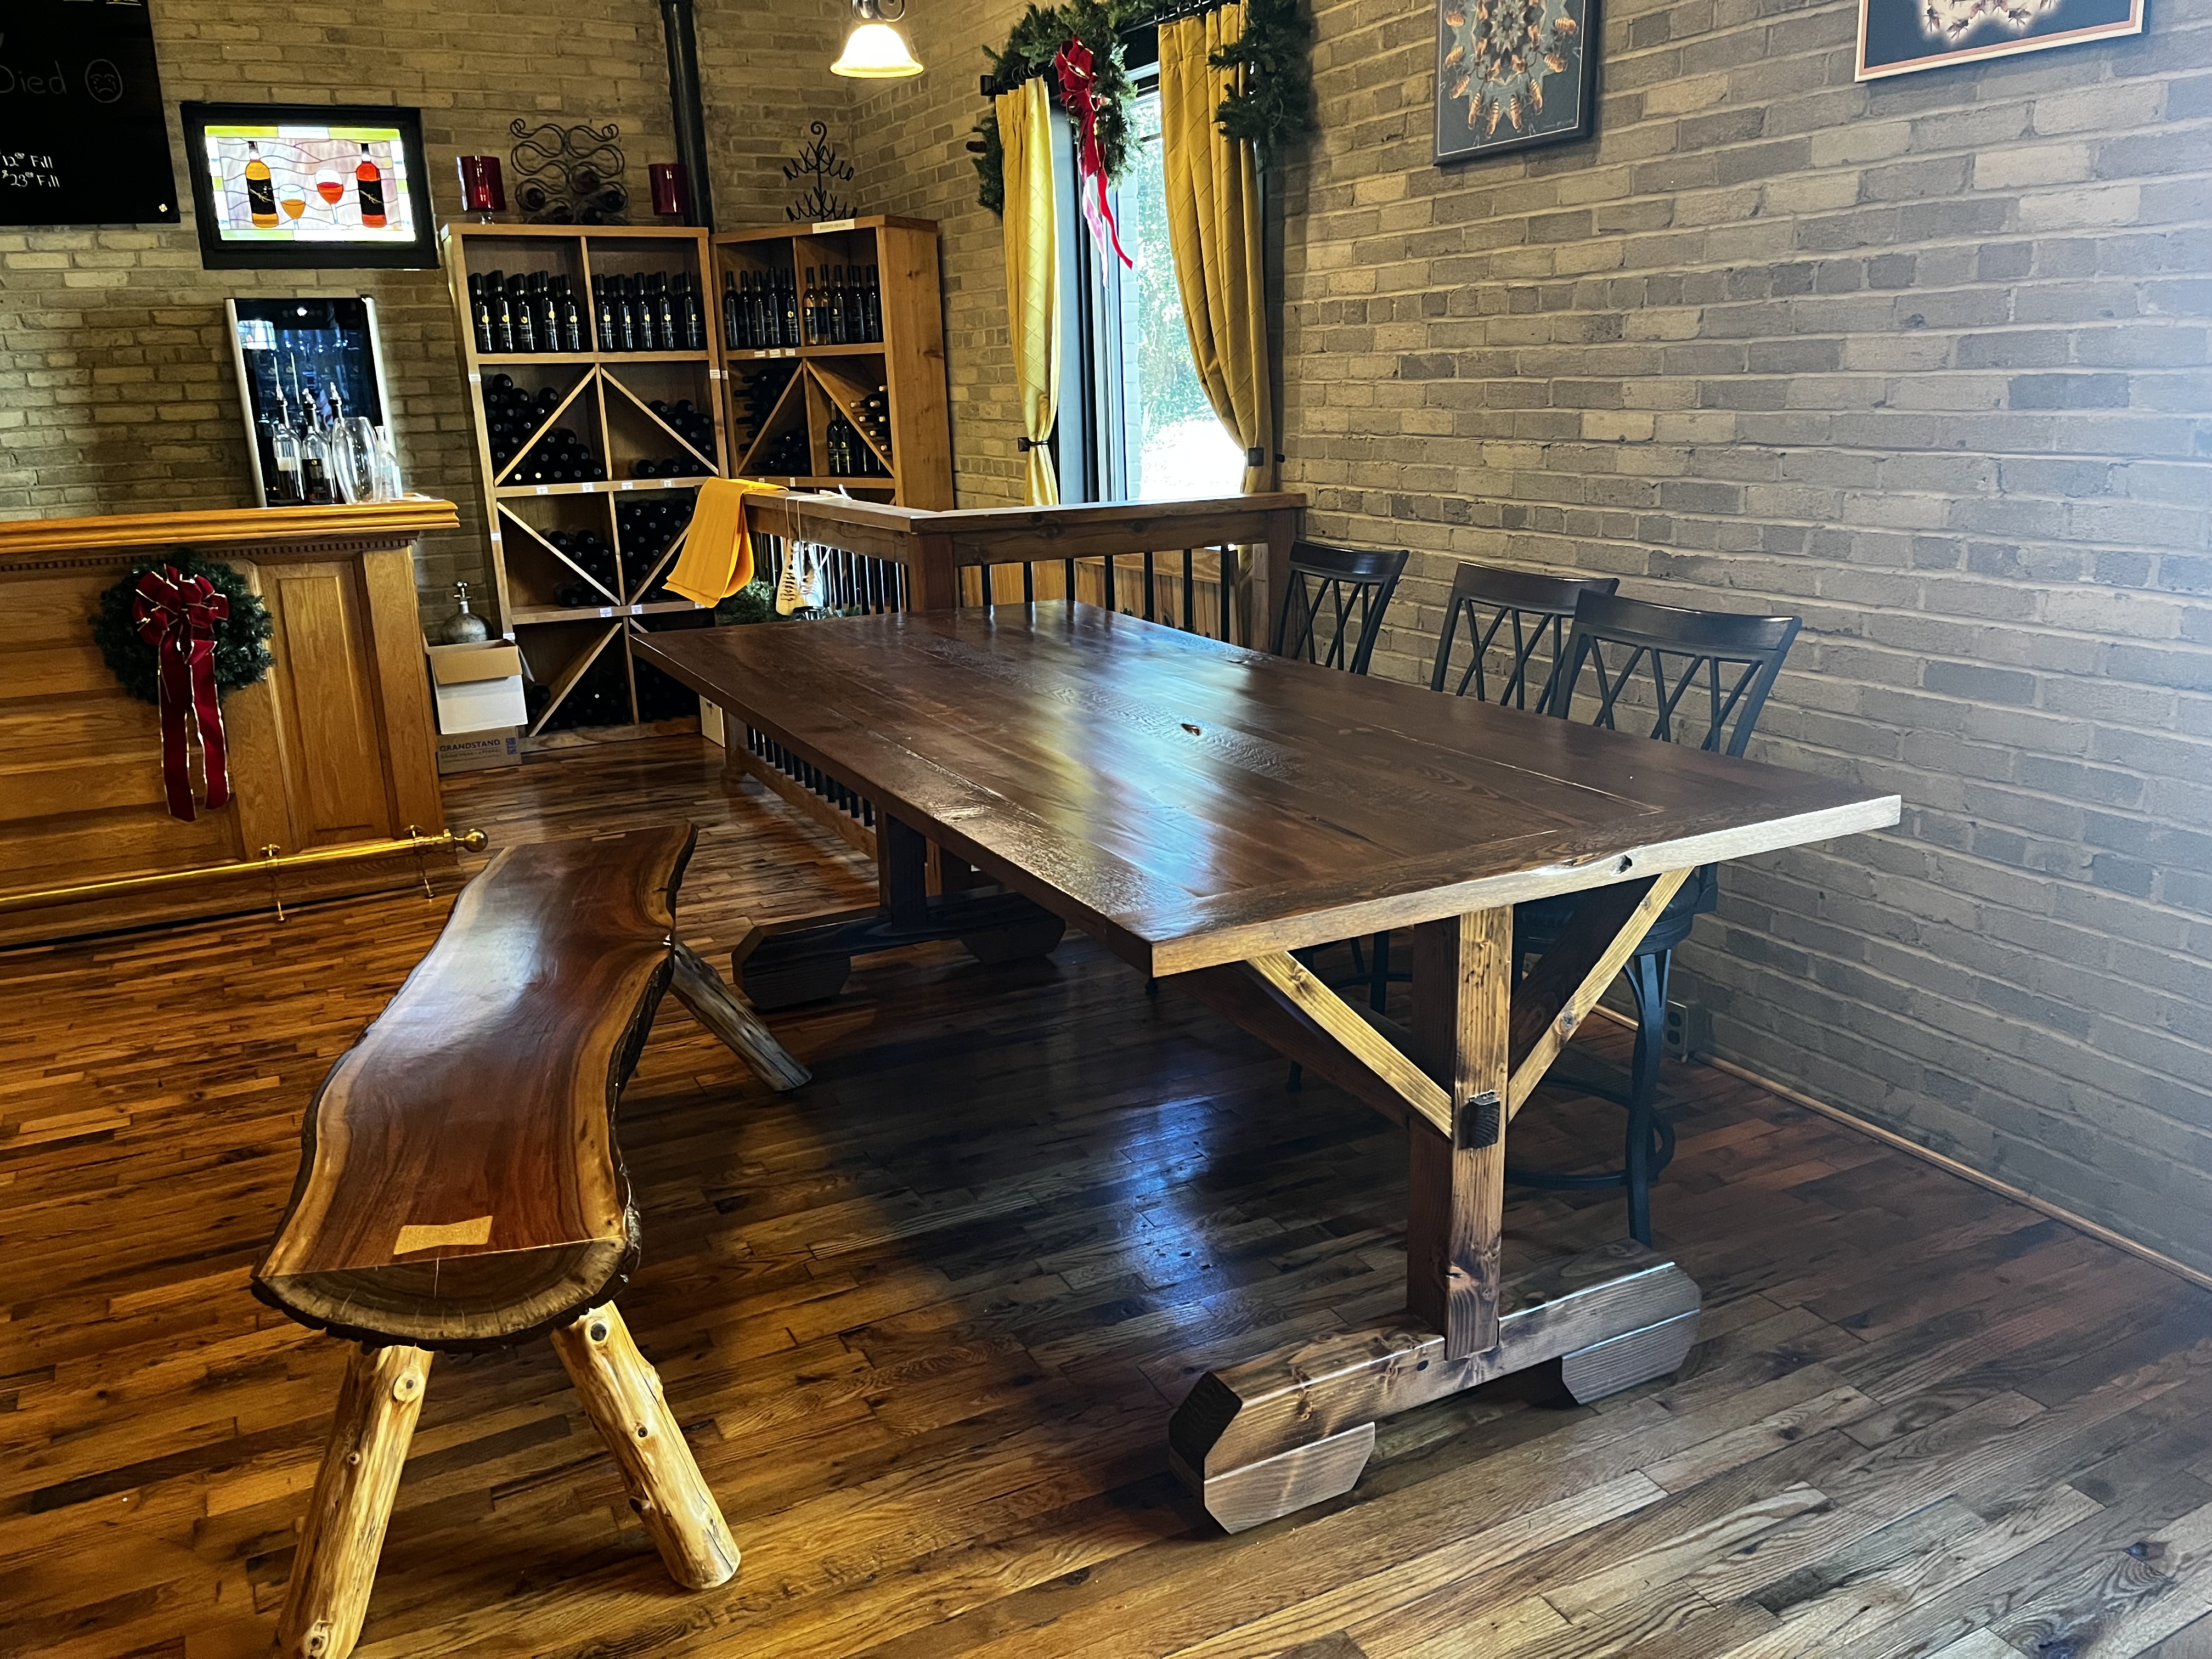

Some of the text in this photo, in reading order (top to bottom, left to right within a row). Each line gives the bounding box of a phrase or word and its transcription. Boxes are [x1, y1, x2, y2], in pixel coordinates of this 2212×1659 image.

[30, 155, 53, 169] Fill
[36, 174, 60, 188] Fill
[440, 739, 500, 752] GRANDSTAND
